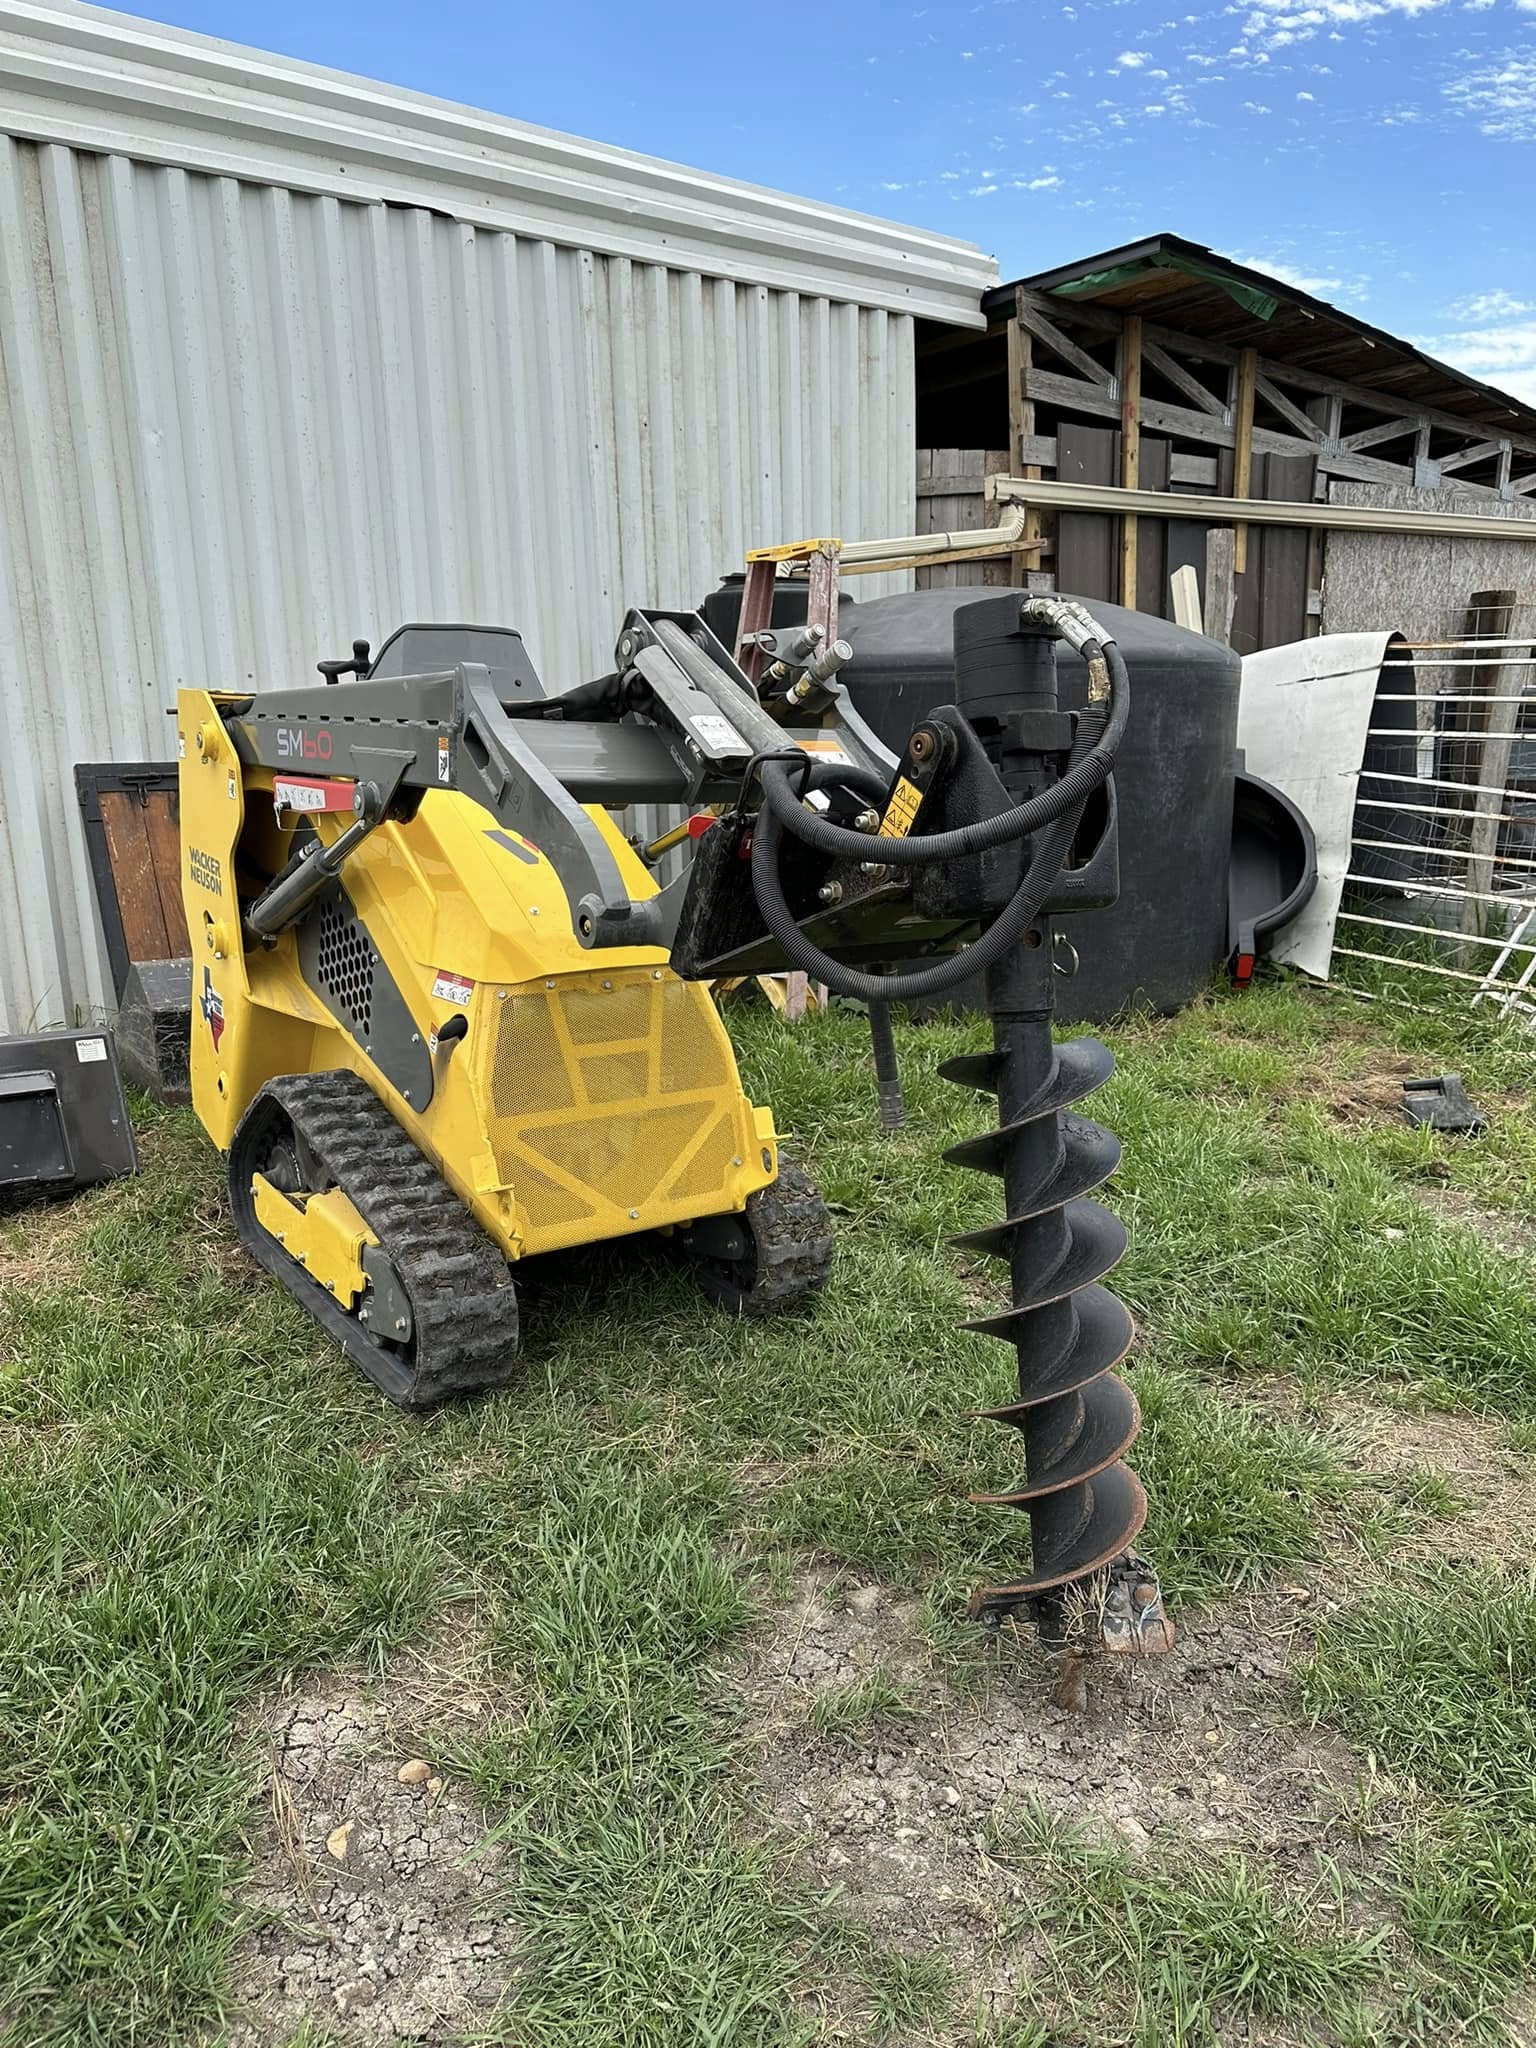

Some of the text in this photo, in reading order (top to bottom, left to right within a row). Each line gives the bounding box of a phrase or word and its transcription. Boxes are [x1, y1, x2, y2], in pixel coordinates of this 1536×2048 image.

[277, 728, 333, 760] SM60
[189, 845, 221, 878] WACKER
[191, 863, 222, 896] NEUSON
